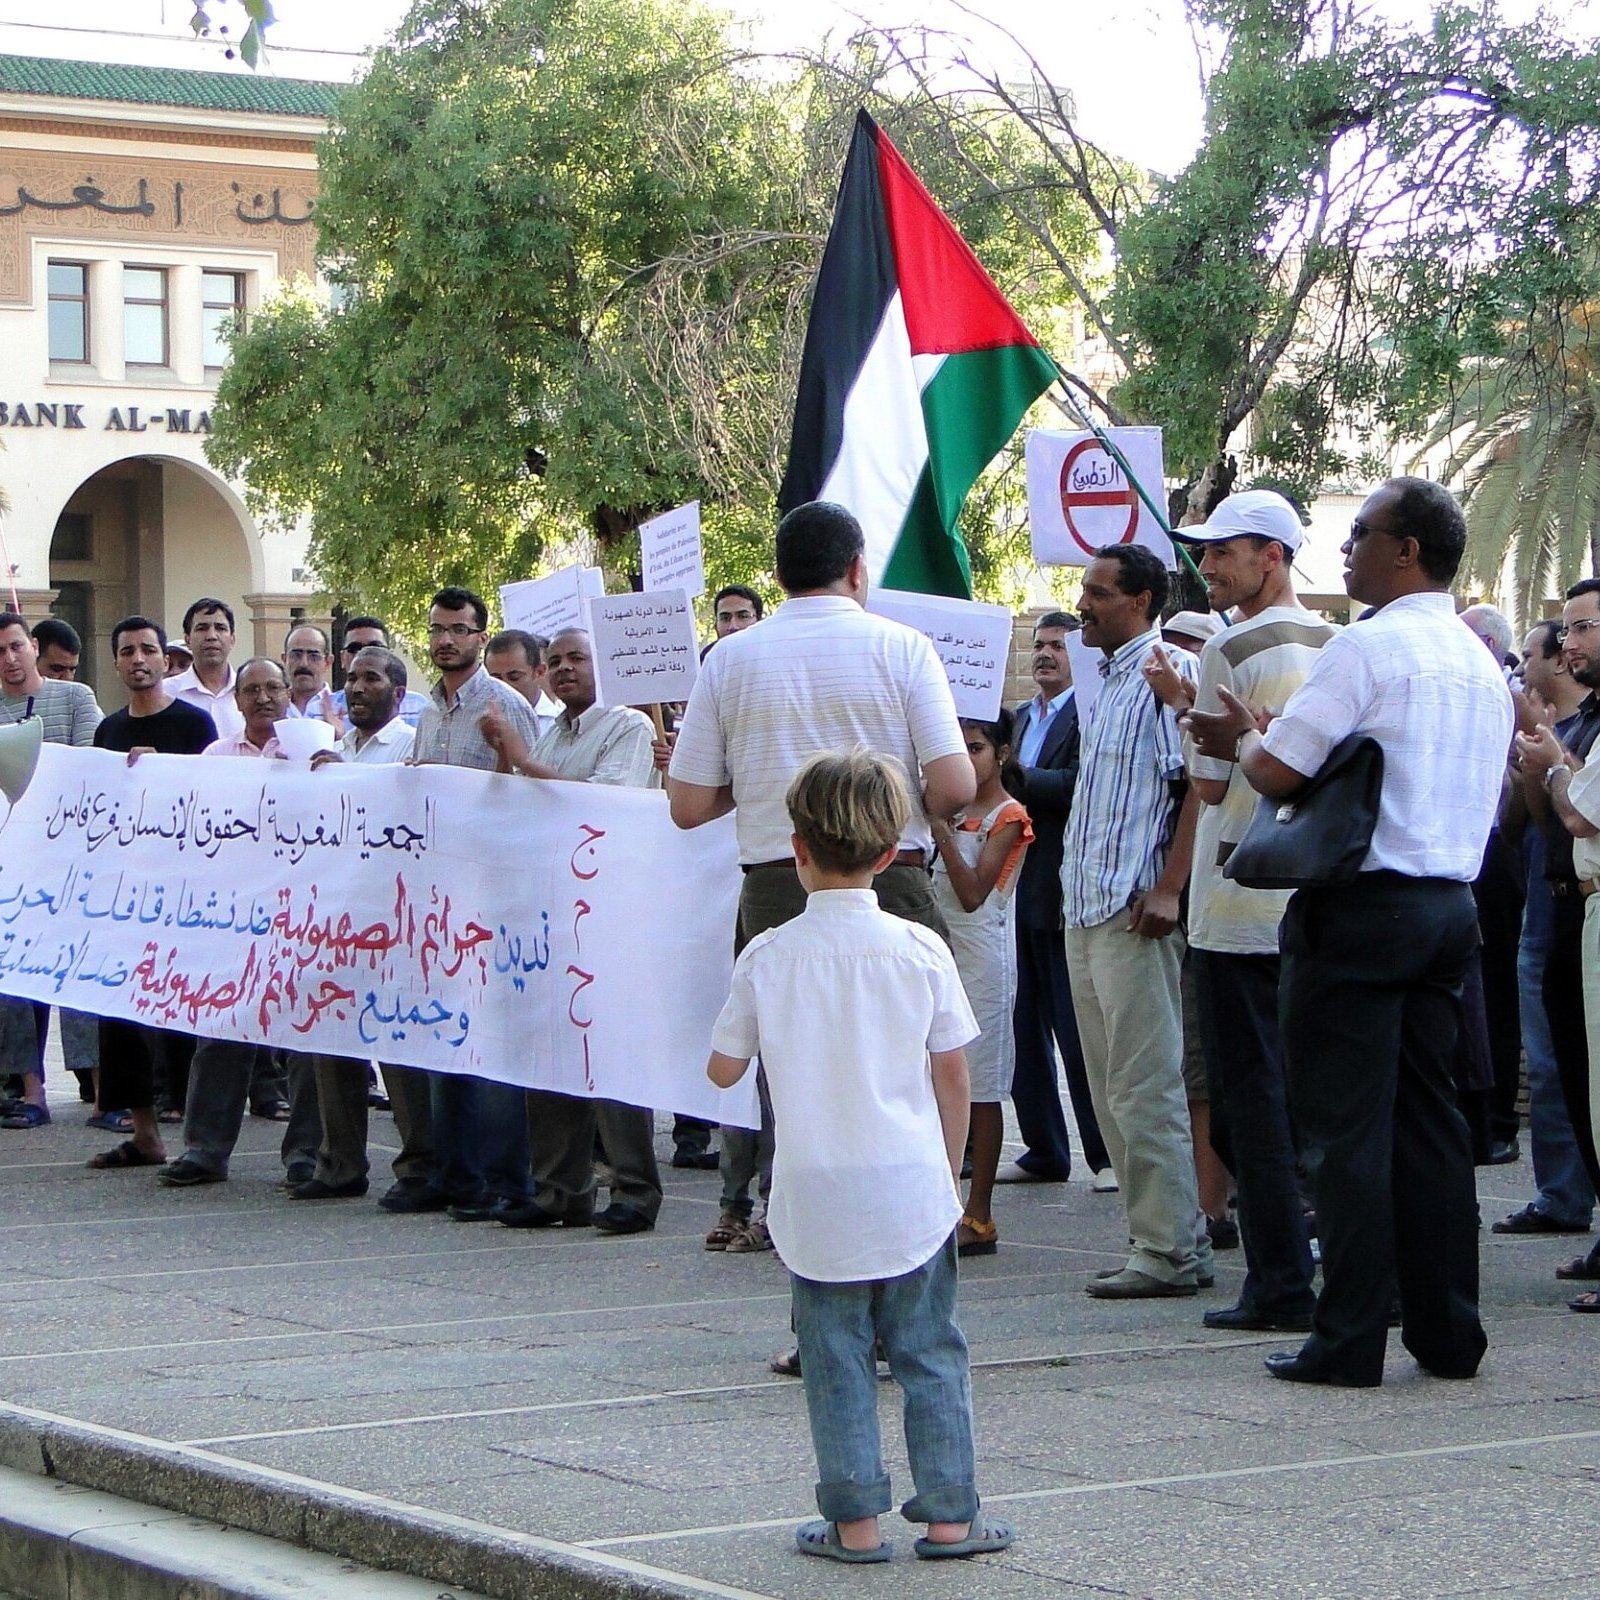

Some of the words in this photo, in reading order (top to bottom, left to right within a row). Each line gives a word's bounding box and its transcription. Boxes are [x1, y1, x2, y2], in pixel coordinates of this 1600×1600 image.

[104, 407, 214, 434] AL-MA
[1073, 461, 1119, 491] التطبيع
[940, 654, 962, 666] للجرا
[194, 783, 267, 859] لحقوق
[268, 792, 351, 866] المغربية
[356, 794, 436, 860] الجمعية
[78, 870, 164, 925] قافلة
[164, 878, 236, 930] نشطاء
[235, 899, 272, 936] ضد
[271, 871, 416, 973] الصهيونية
[78, 951, 128, 987] ضد
[421, 884, 494, 993] جرائم
[495, 911, 549, 993] ندين
[130, 941, 262, 1030] الصهيونية
[259, 953, 356, 1037] جرائم
[358, 990, 470, 1047] وجميع
